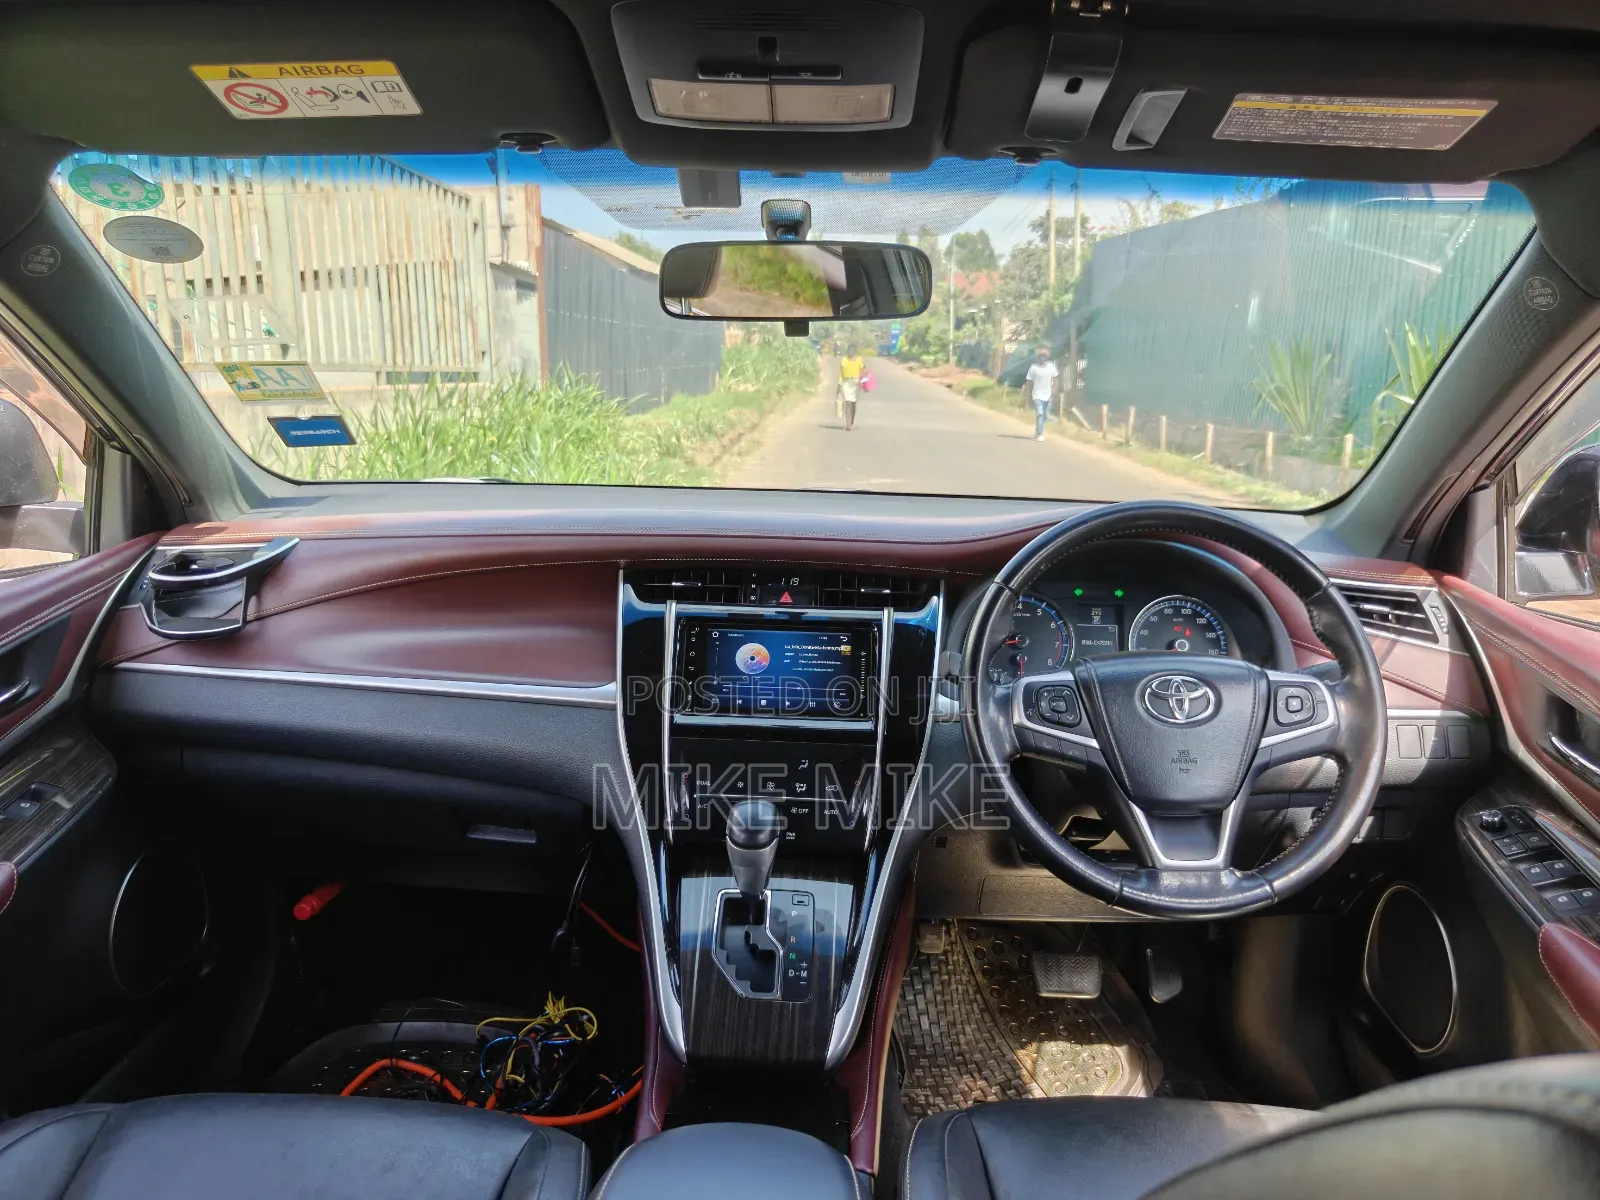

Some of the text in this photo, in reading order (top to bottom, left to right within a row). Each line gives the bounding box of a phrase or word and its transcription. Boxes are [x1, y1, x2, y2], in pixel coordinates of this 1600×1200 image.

[278, 64, 366, 77] AIRBAG
[253, 367, 309, 388] AA
[289, 428, 341, 437] RESEARCH
[1017, 602, 1023, 610] 4
[1036, 608, 1042, 616] 5
[1050, 621, 1056, 629] 6
[1054, 641, 1060, 649] 7
[790, 935, 796, 943] R
[789, 952, 796, 960] N
